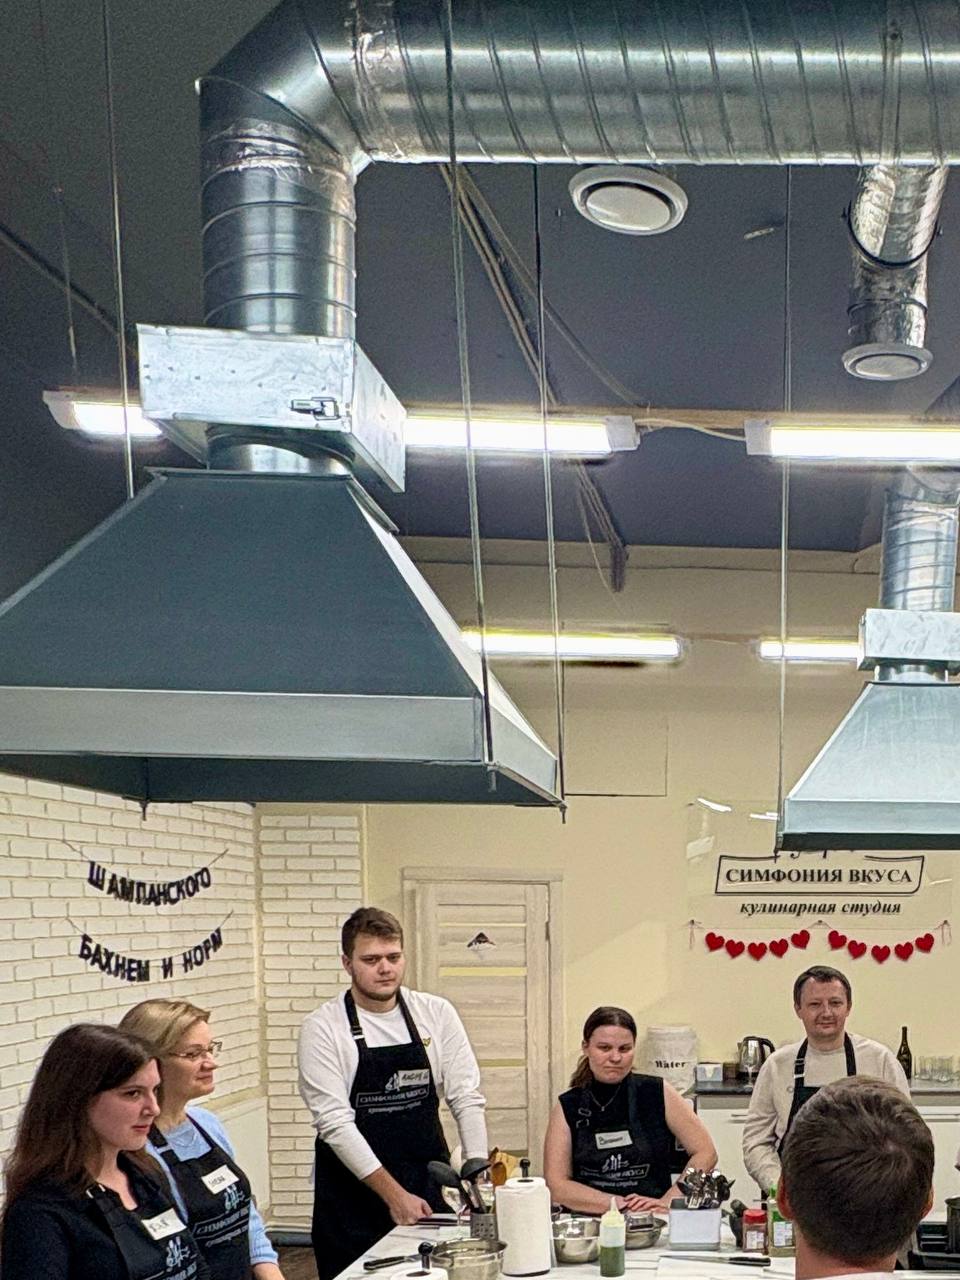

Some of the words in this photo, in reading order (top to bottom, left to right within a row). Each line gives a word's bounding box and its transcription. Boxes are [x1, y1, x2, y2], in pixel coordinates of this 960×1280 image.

[87, 860, 212, 906] ШАМПАНСКОГО
[725, 868, 842, 883] СИМФОНИЯ
[848, 868, 912, 883] ВКУСА
[740, 902, 836, 917] кулинарная
[841, 900, 902, 917] студия
[79, 933, 151, 983] БАХНЕМ
[161, 956, 174, 980] И
[182, 927, 223, 974] НОРМ
